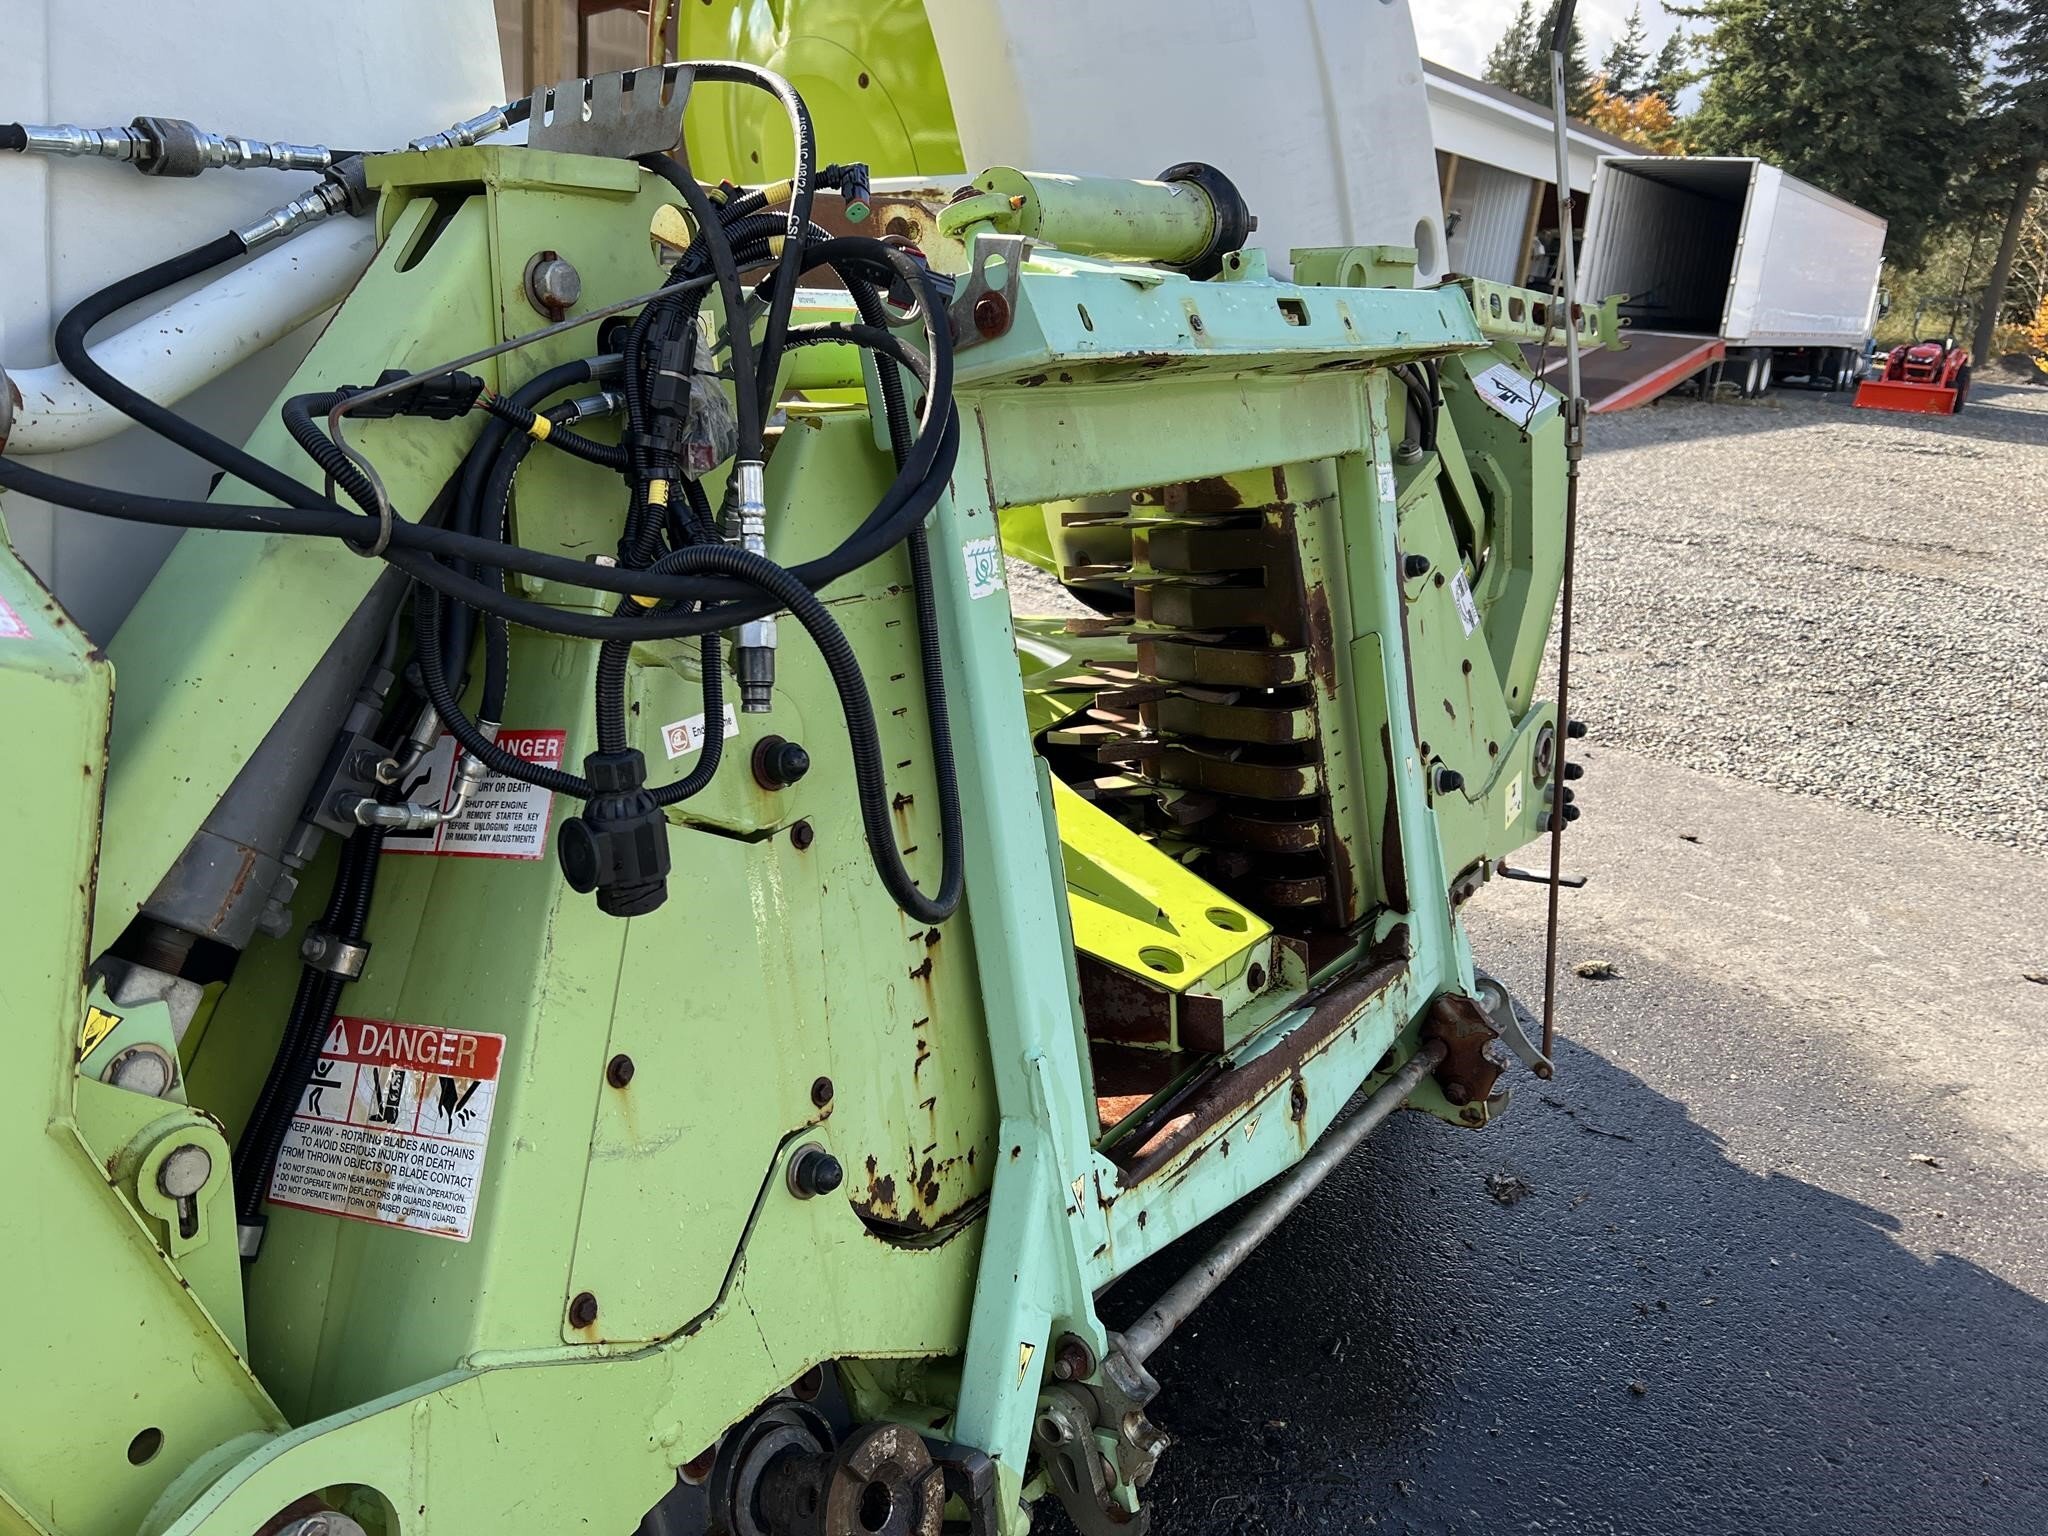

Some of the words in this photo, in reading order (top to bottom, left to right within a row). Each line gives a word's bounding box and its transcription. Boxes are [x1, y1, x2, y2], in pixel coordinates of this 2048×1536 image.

[787, 215, 800, 240] CSI
[497, 738, 559, 757] ANGER
[495, 782, 506, 792] OR
[508, 782, 532, 793] DEATH
[464, 800, 484, 808] SHUT
[485, 800, 499, 808] OFF
[500, 801, 528, 810] ENGINE
[466, 812, 492, 820] REMOVE
[496, 812, 523, 820] STARTER
[527, 813, 540, 821] KEY
[448, 821, 470, 830] BEFORE
[514, 824, 538, 832] HEADER
[454, 833, 478, 842] MAKING
[478, 834, 492, 842] ANY
[492, 834, 536, 844] ADJUSTMENTS
[358, 1024, 478, 1069] DANGER
[289, 1121, 310, 1132] KEEP
[311, 1124, 334, 1136] AWAY
[341, 1129, 382, 1145] ROTATING
[384, 1136, 418, 1151] BLADES
[420, 1142, 438, 1154] AND
[440, 1146, 475, 1160] CHAINS
[302, 1136, 312, 1146] TO
[313, 1138, 338, 1150] AVOID
[340, 1142, 376, 1158] SERIOUS
[378, 1148, 410, 1162] INJURY
[410, 1154, 424, 1166] OR
[426, 1156, 456, 1170] DEATH
[282, 1146, 304, 1159] FROM
[306, 1150, 342, 1165] THROWN
[344, 1156, 382, 1172] OBJECTS
[384, 1164, 398, 1175] OR
[399, 1166, 429, 1181] BLADE
[430, 1172, 473, 1188] CONTACT
[282, 1162, 292, 1170] DO
[292, 1164, 305, 1173] NOT
[306, 1166, 326, 1176] STAND
[326, 1170, 336, 1178] ON
[337, 1172, 346, 1180] OR
[348, 1174, 365, 1183] NEAR
[366, 1176, 396, 1190] MACHINE
[397, 1182, 416, 1194] WHEN
[278, 1184, 287, 1192] DO
[288, 1186, 301, 1194] NOT
[302, 1188, 329, 1200] OPERATE
[330, 1194, 346, 1203] WITH
[347, 1196, 364, 1207] TORN
[365, 1200, 375, 1208] OR
[376, 1202, 400, 1214] RAISED
[402, 1206, 430, 1220] CURTAIN
[280, 1172, 290, 1181] DO
[290, 1174, 303, 1183] NOT
[304, 1177, 331, 1190] OPERATE
[332, 1183, 348, 1193] WITH
[349, 1185, 390, 1200] DEFLECTORS
[392, 1194, 402, 1202] OR
[402, 1196, 431, 1208] GUARDS
